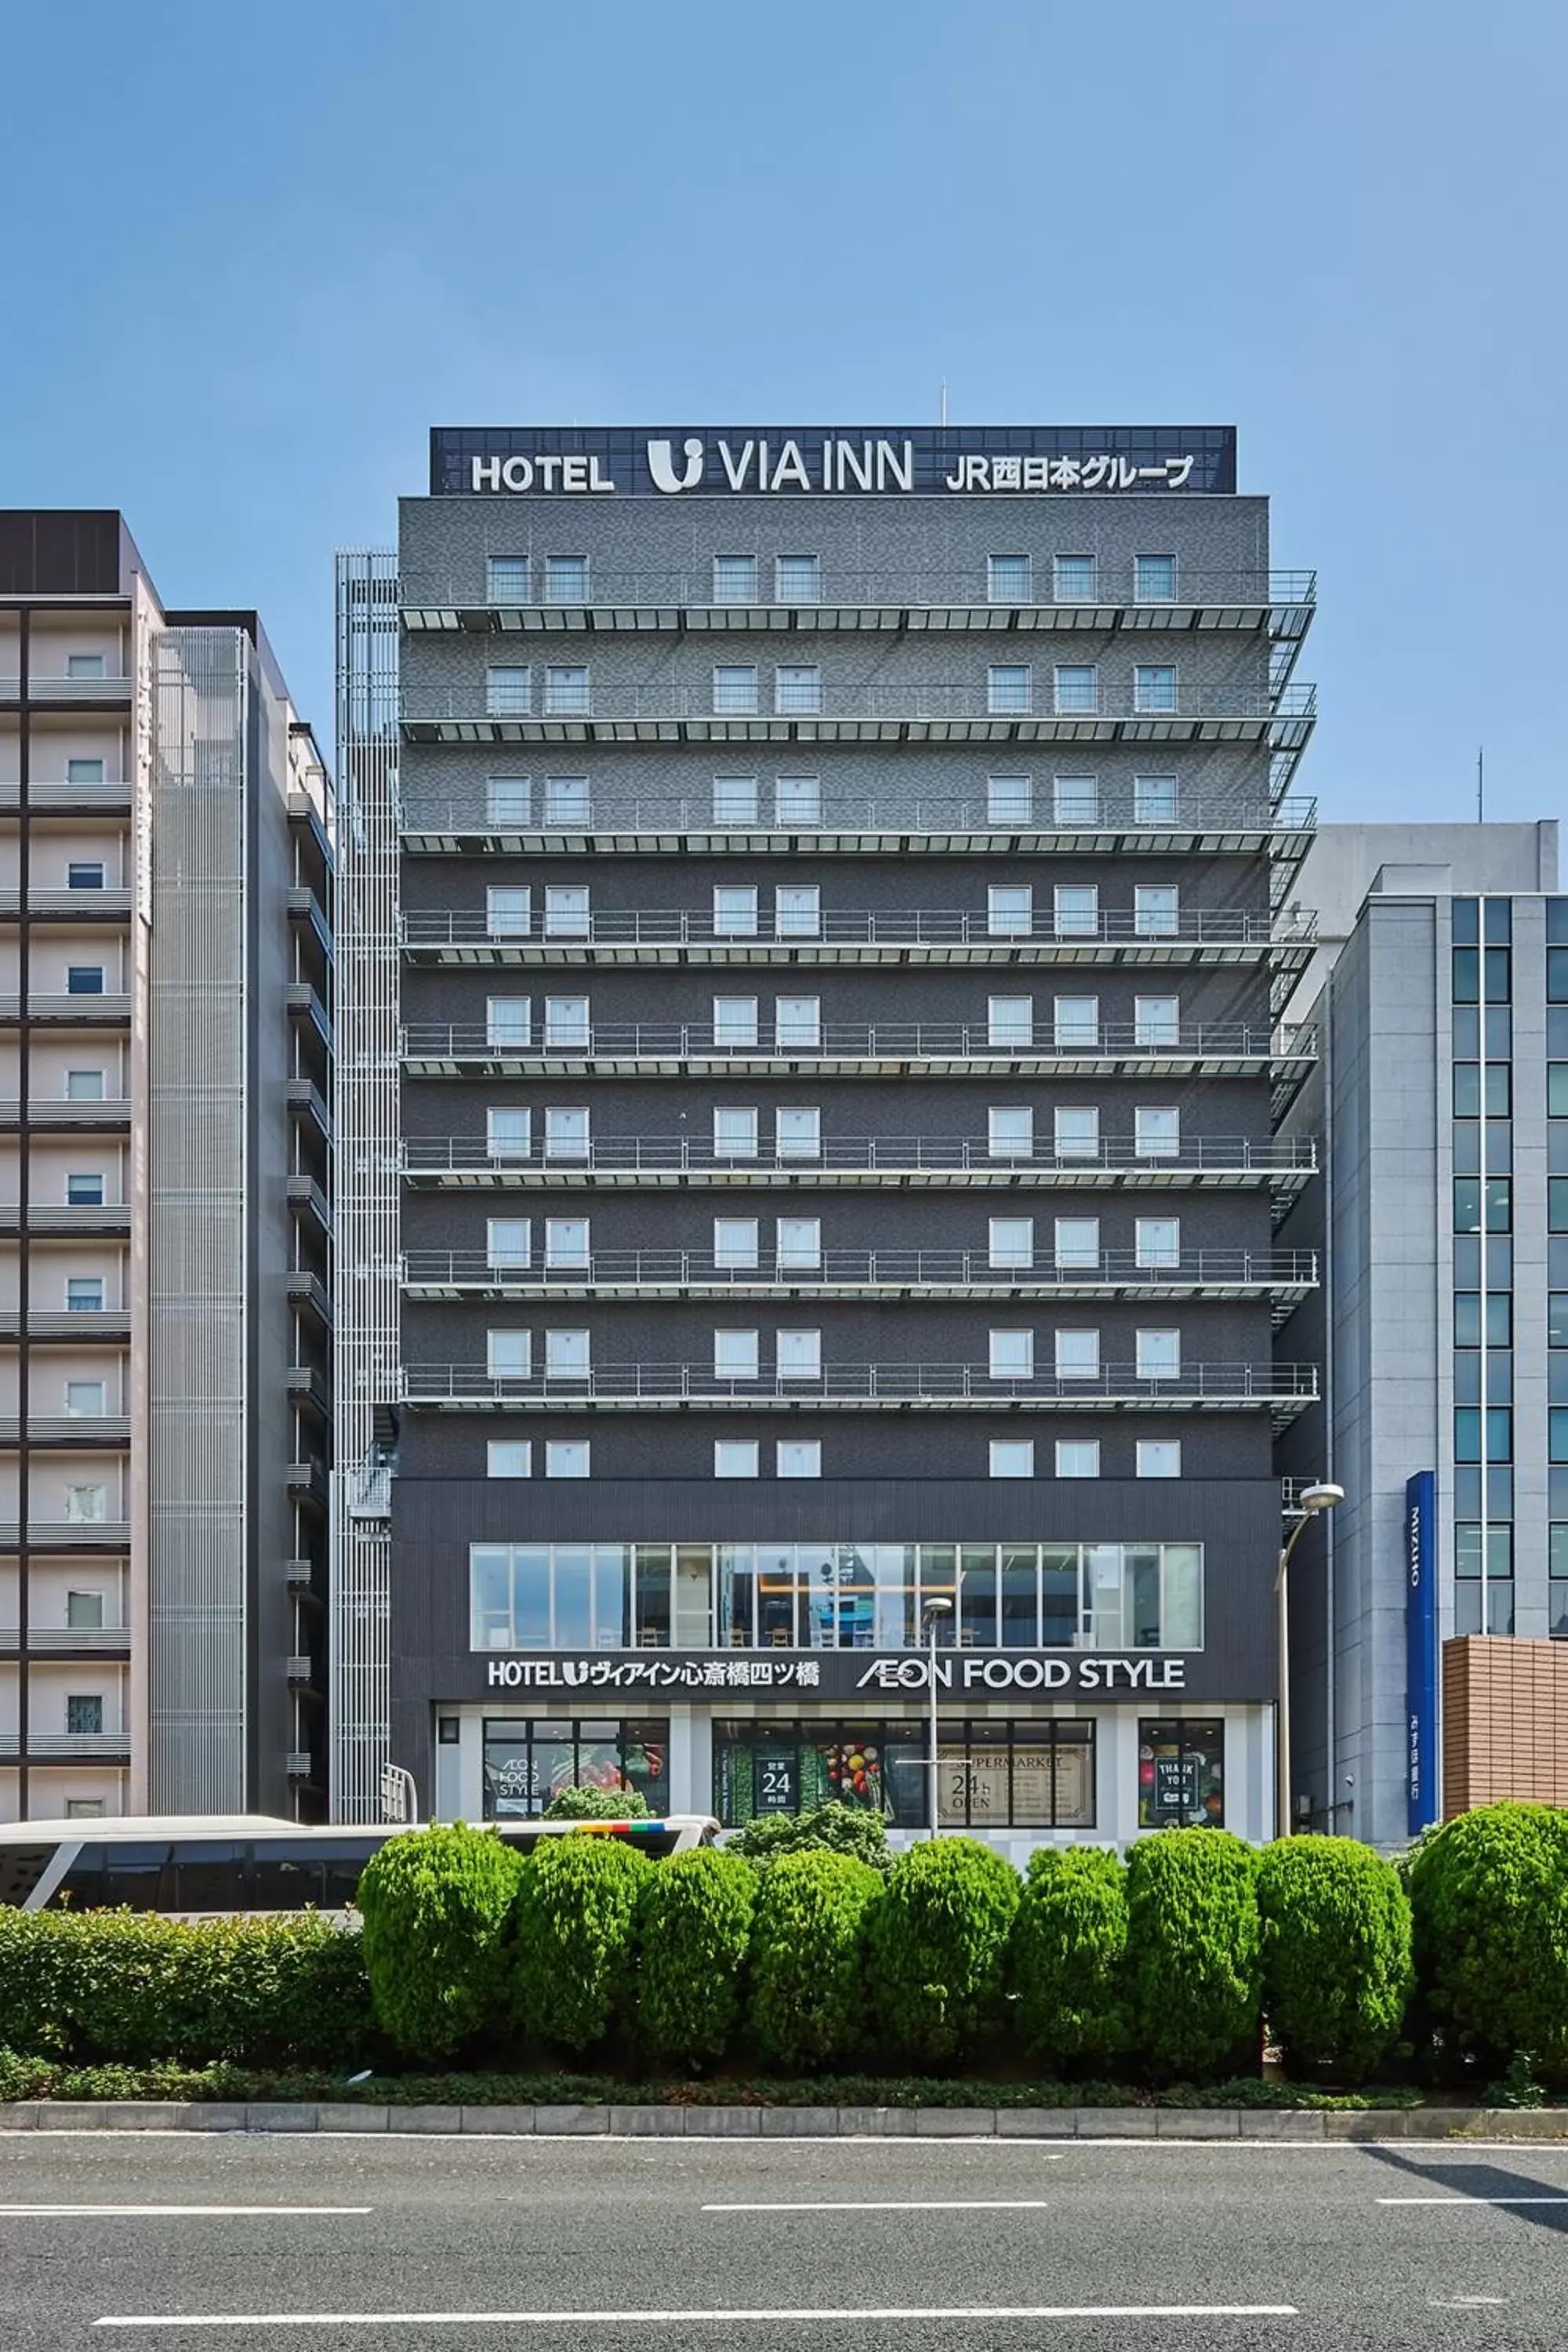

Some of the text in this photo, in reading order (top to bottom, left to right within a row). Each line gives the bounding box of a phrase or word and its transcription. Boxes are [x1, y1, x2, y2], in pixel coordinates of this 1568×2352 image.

[472, 440, 913, 492] HOTEL VIA INN
[946, 455, 1194, 490] JR西日本グループ
[488, 1660, 820, 1686] HOTEL ヴィアイン心斎橋四ツ橋
[964, 1658, 1071, 1688] FOOD
[1078, 1658, 1185, 1688] STYLE
[763, 1773, 791, 1793] 24
[953, 1796, 990, 1809] OEN
